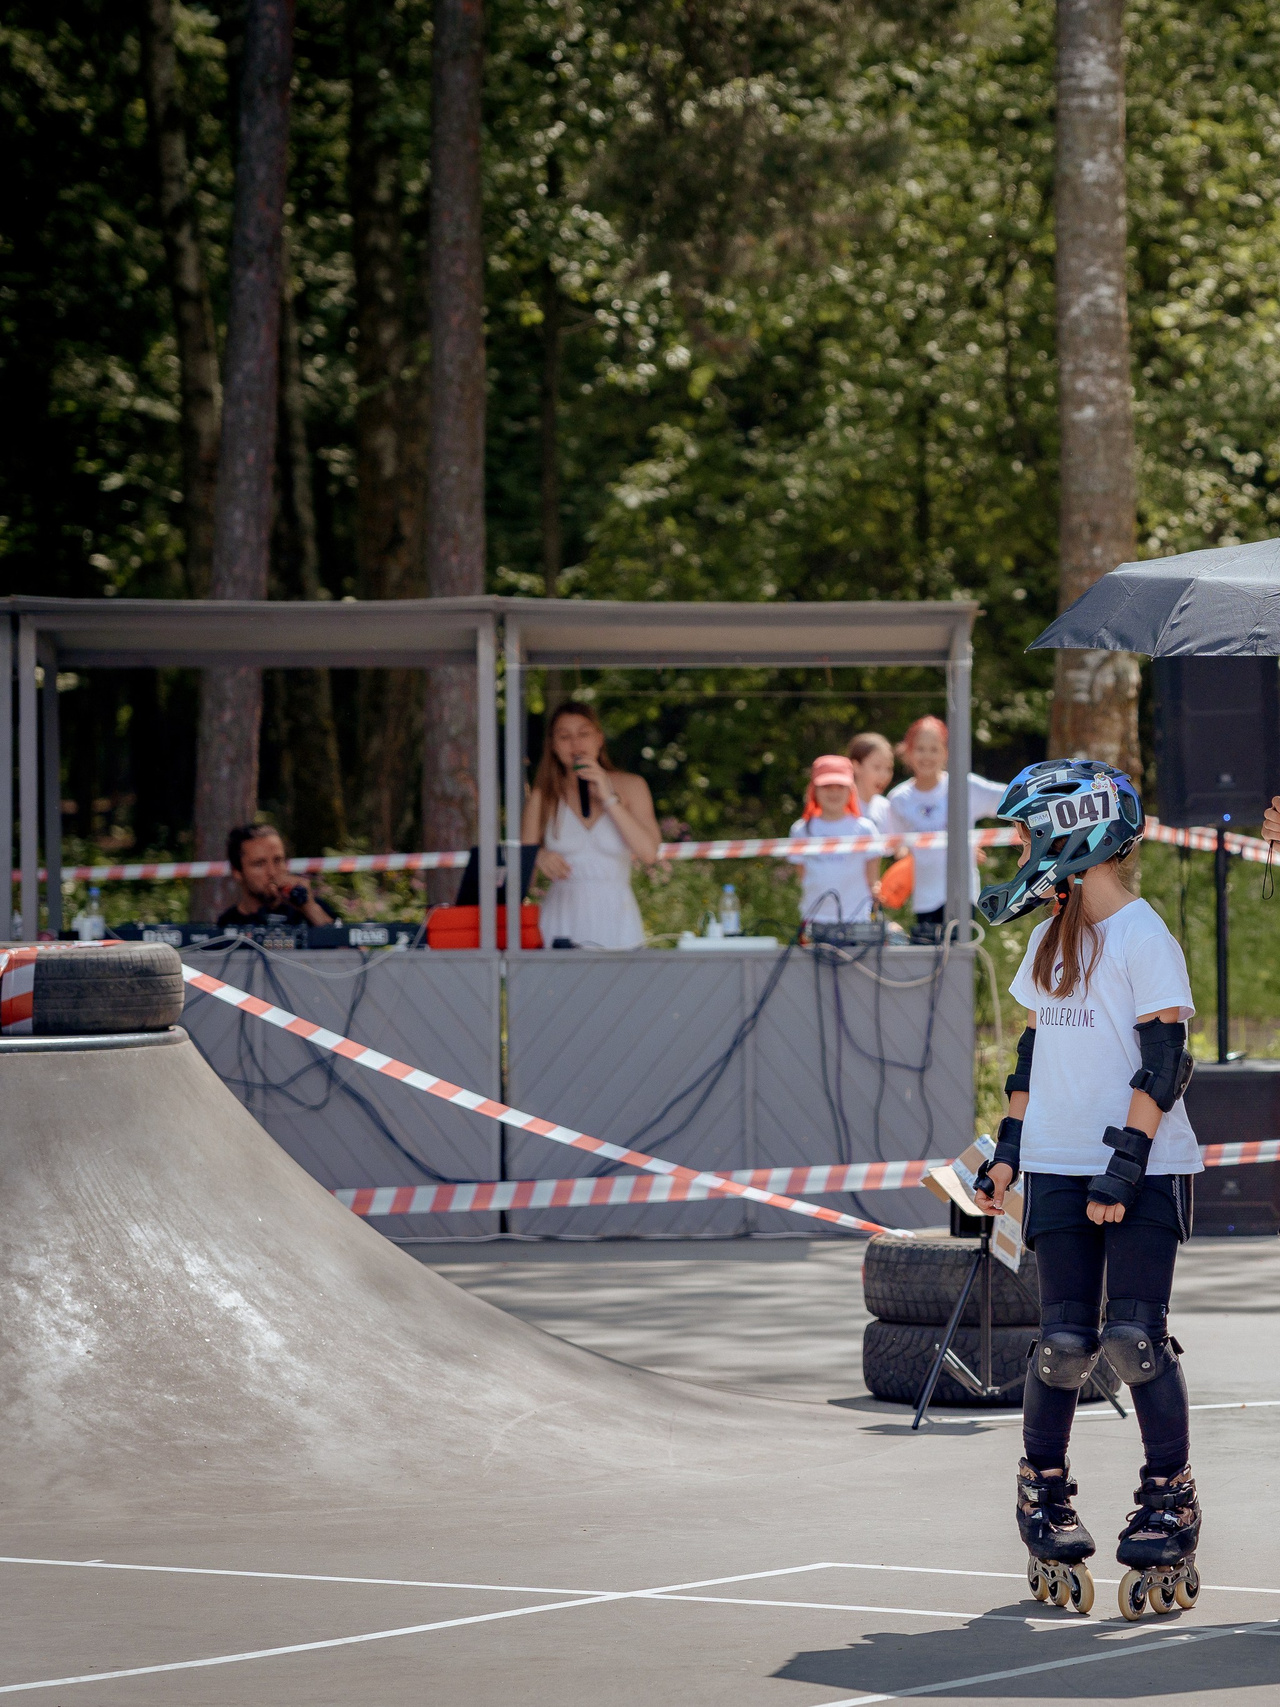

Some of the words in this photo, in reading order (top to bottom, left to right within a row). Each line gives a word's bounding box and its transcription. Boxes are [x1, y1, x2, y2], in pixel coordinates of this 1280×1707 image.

[1055, 791, 1110, 829] 047
[1008, 863, 1058, 914] MET
[1039, 1006, 1096, 1028] ROLLERLINE
